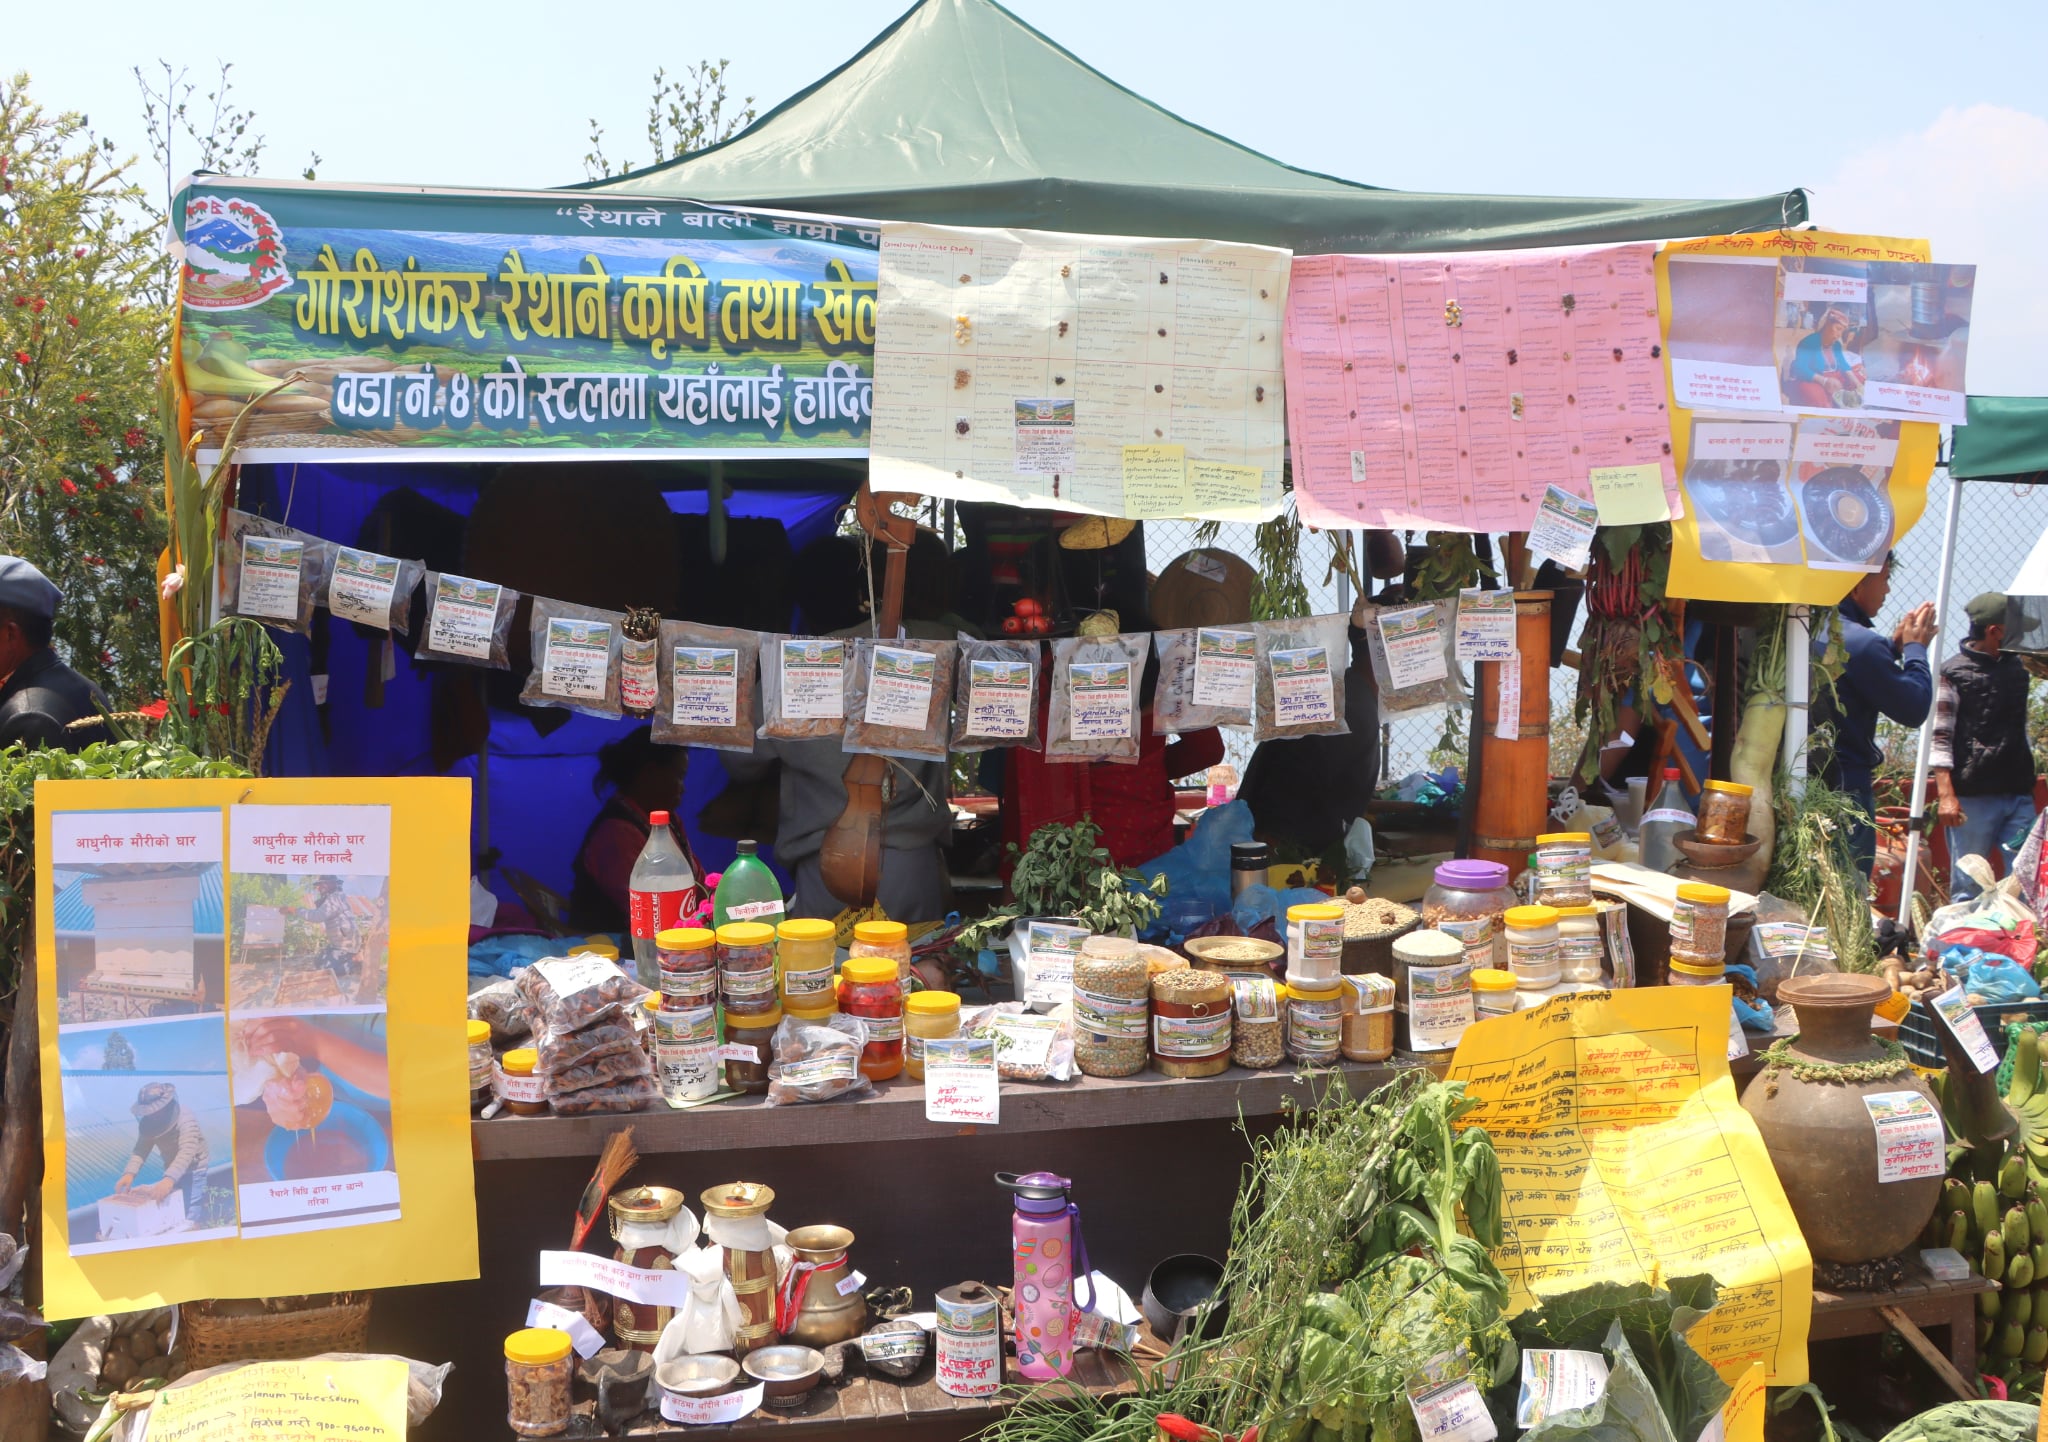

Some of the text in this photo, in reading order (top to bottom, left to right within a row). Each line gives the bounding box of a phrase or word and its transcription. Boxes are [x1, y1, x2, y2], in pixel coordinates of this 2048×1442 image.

[682, 210, 757, 230] बाली
[772, 218, 843, 242] हाम्रो
[296, 243, 488, 341] गौरीशंकर
[499, 247, 611, 342] रैथाने
[622, 254, 710, 360] कृषि
[720, 278, 804, 344] तथा
[336, 371, 395, 419] वडा
[403, 362, 442, 418] नं.
[483, 356, 527, 420] को
[536, 371, 649, 425] स्टलमा
[657, 361, 782, 429] यहाँलाई
[76, 832, 197, 852] आधुनीक मौरीको घार
[252, 831, 366, 851] आधुनीक मौरीको घार
[264, 848, 353, 865] बाट मह निकाल्दै
[307, 1198, 329, 1207] तरिका
